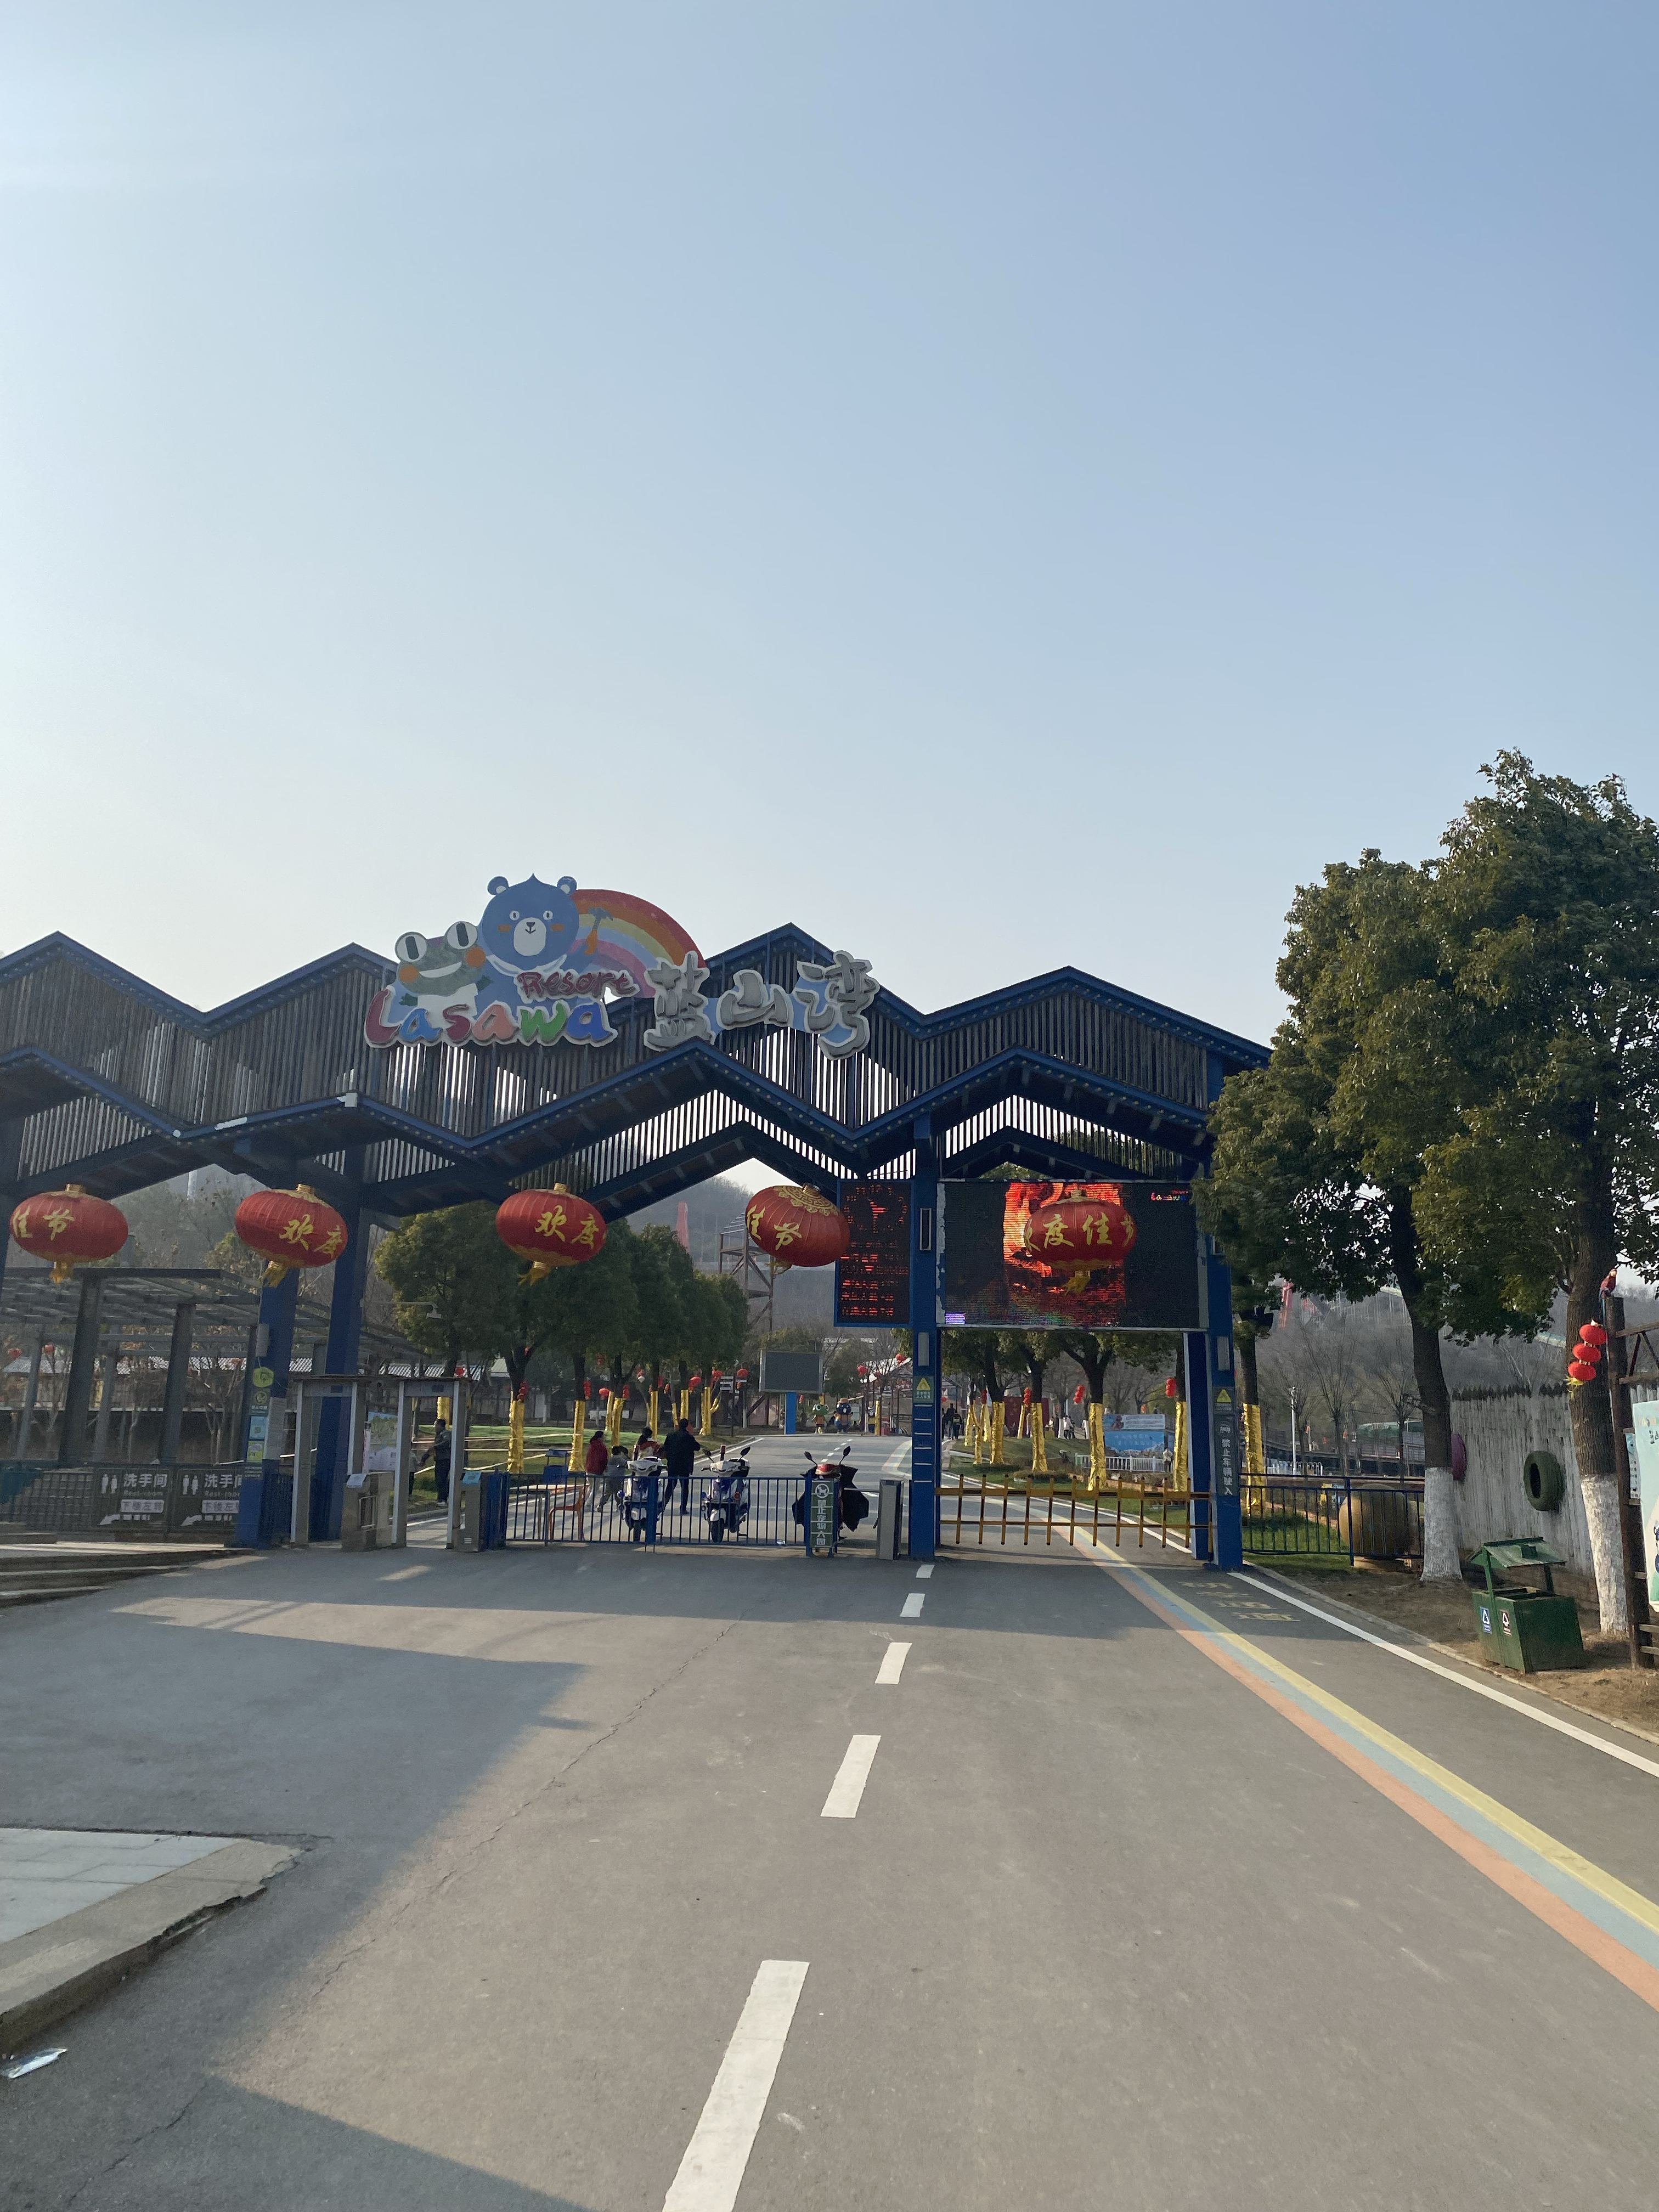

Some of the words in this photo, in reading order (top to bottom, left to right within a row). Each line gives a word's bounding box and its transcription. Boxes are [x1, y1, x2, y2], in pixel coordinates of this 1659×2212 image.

[517, 969, 639, 999] Resort
[365, 987, 609, 1043] Lasawa
[13, 1206, 75, 1241] 佳节
[279, 1214, 343, 1259] 欢度
[534, 1205, 599, 1249] 欢度
[747, 1205, 802, 1251] 佳节
[123, 1473, 167, 1487] 洗手间
[1222, 1438, 1233, 1495] 禁止车辆驶入
[203, 1502, 239, 1511] 下楼左
